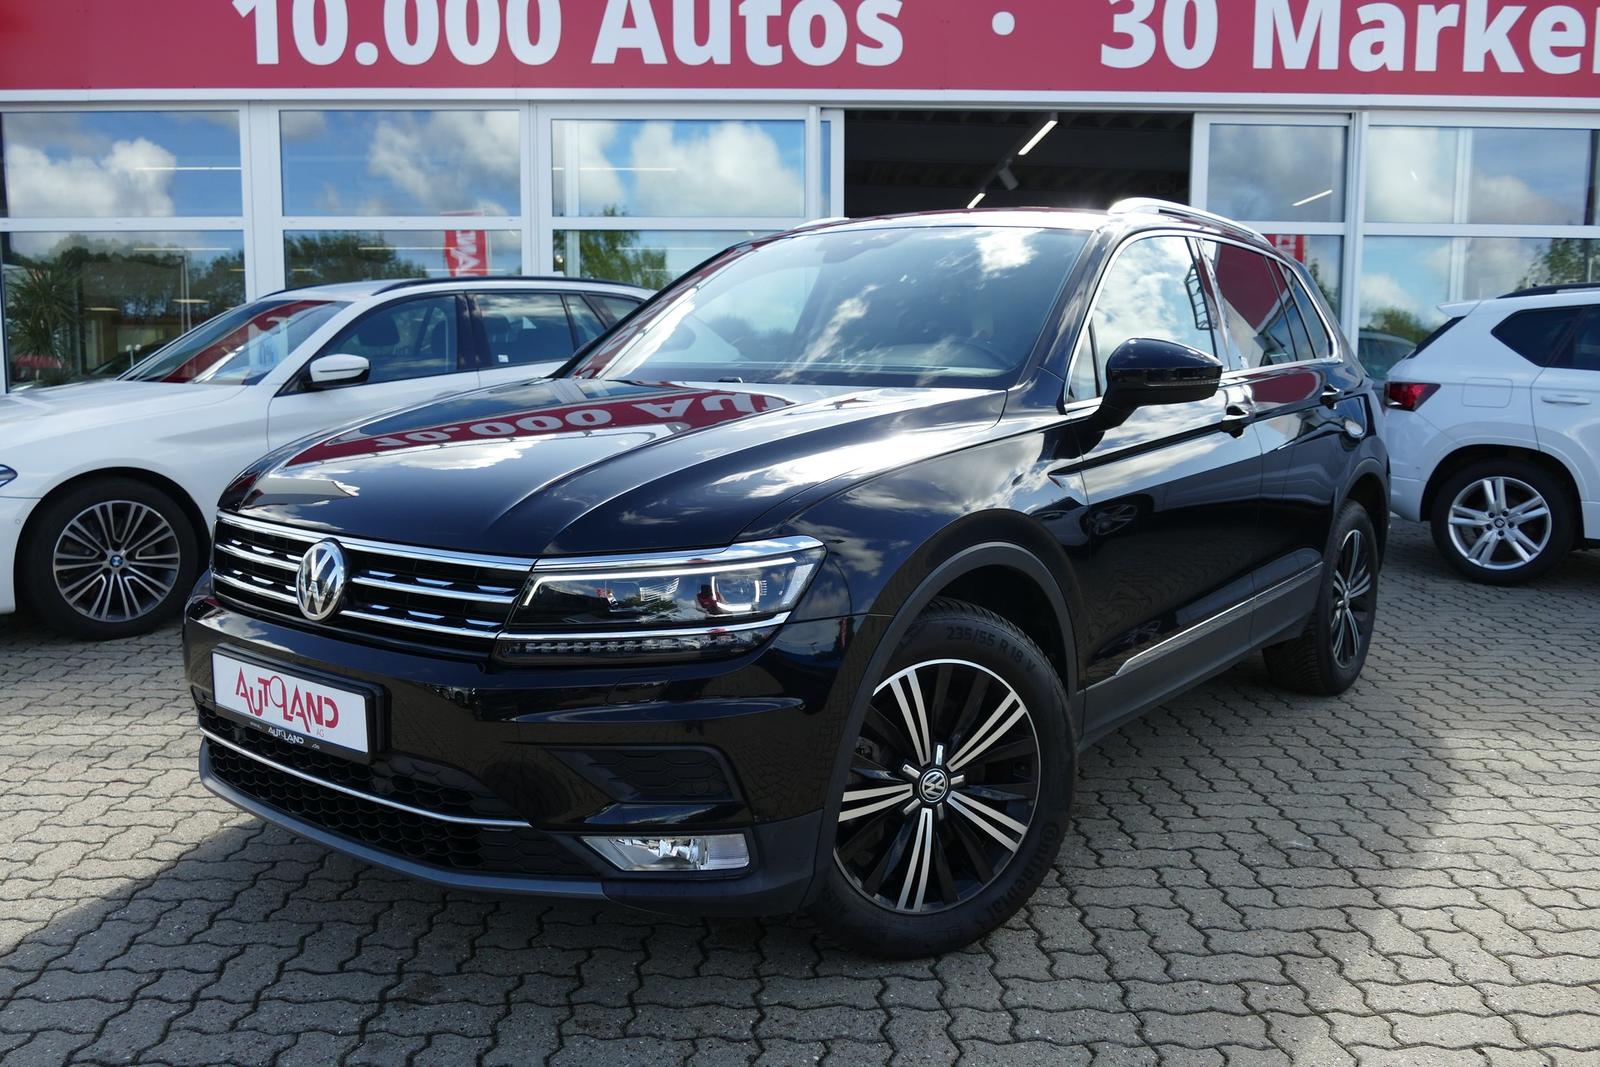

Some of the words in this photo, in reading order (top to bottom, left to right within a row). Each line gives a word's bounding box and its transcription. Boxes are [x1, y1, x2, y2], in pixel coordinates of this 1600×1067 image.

[232, 0, 563, 66] 10.000
[590, 0, 904, 67] Autos
[1099, 0, 1218, 69] 30
[1251, 0, 1600, 75] Marke
[296, 541, 344, 620] VW
[946, 626, 996, 647] 235/55
[235, 667, 339, 733] AUTOLAND
[267, 726, 305, 745] AUTOLAND
[919, 768, 948, 803] VW
